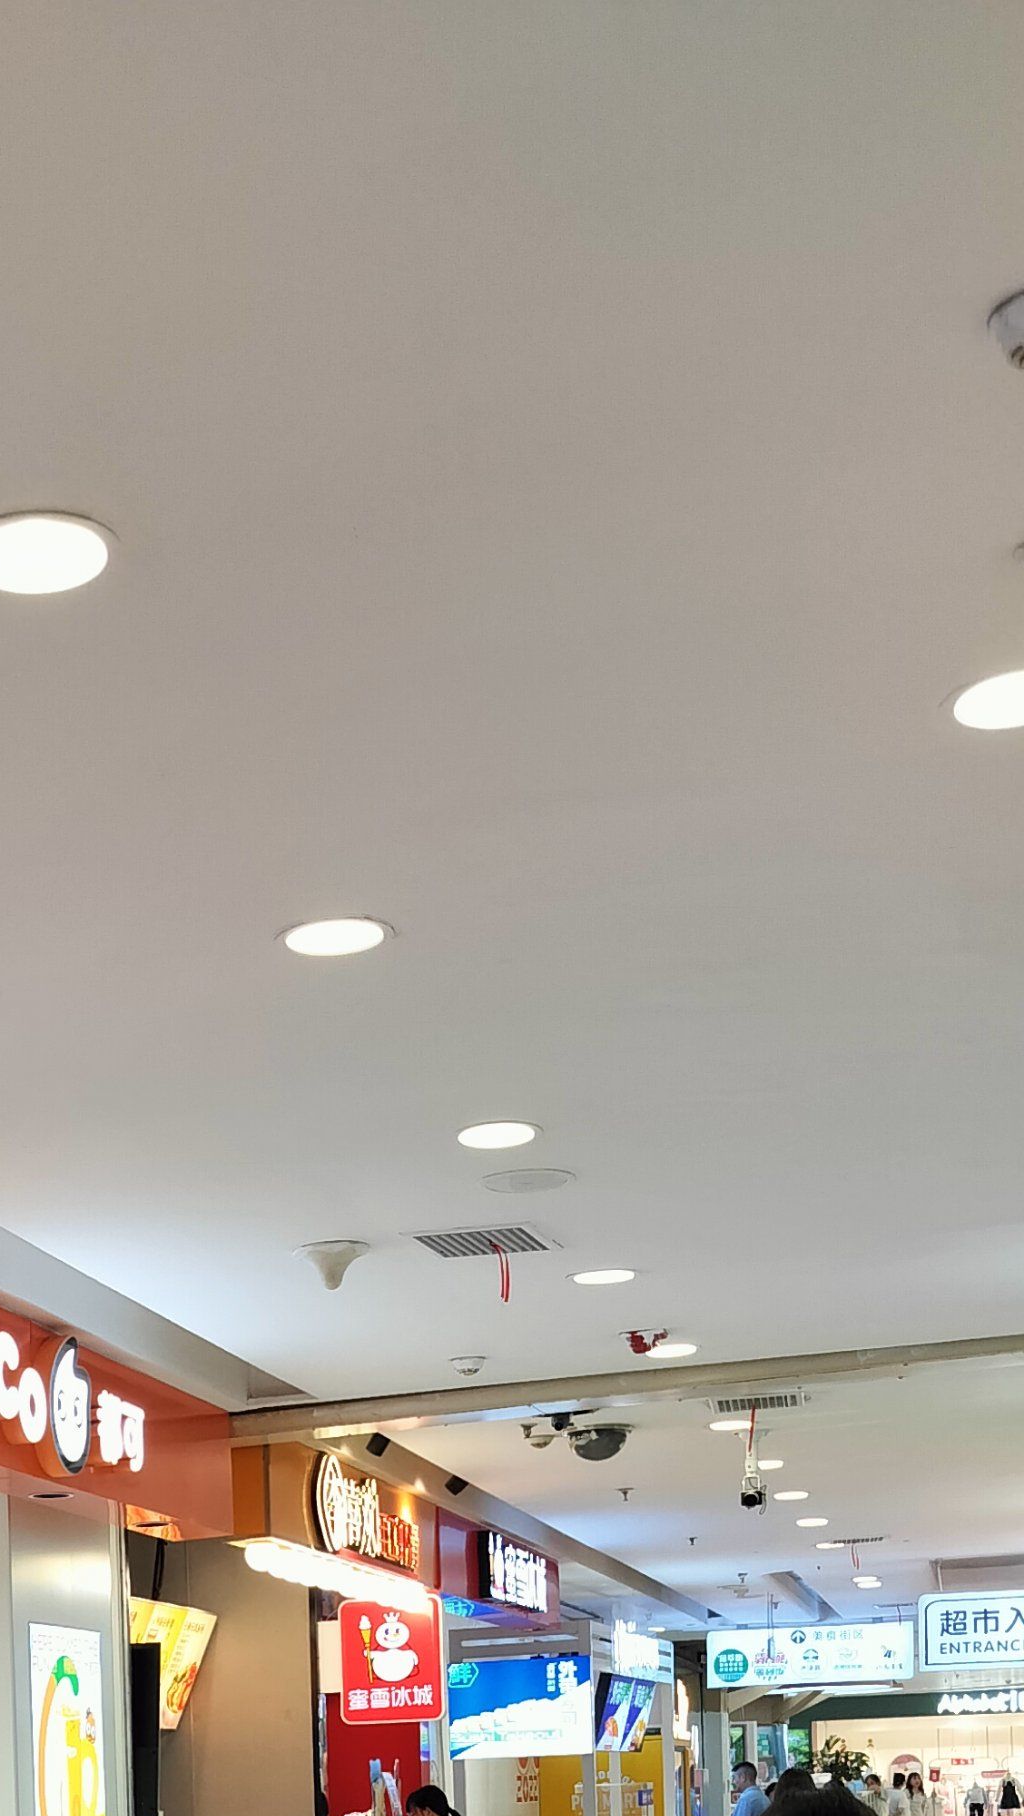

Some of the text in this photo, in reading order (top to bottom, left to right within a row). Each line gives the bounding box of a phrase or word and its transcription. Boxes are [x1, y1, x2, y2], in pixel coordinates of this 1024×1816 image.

[939, 1639, 1024, 1655] ENTRANC
[347, 1684, 434, 1711] 蜜雪冰城
